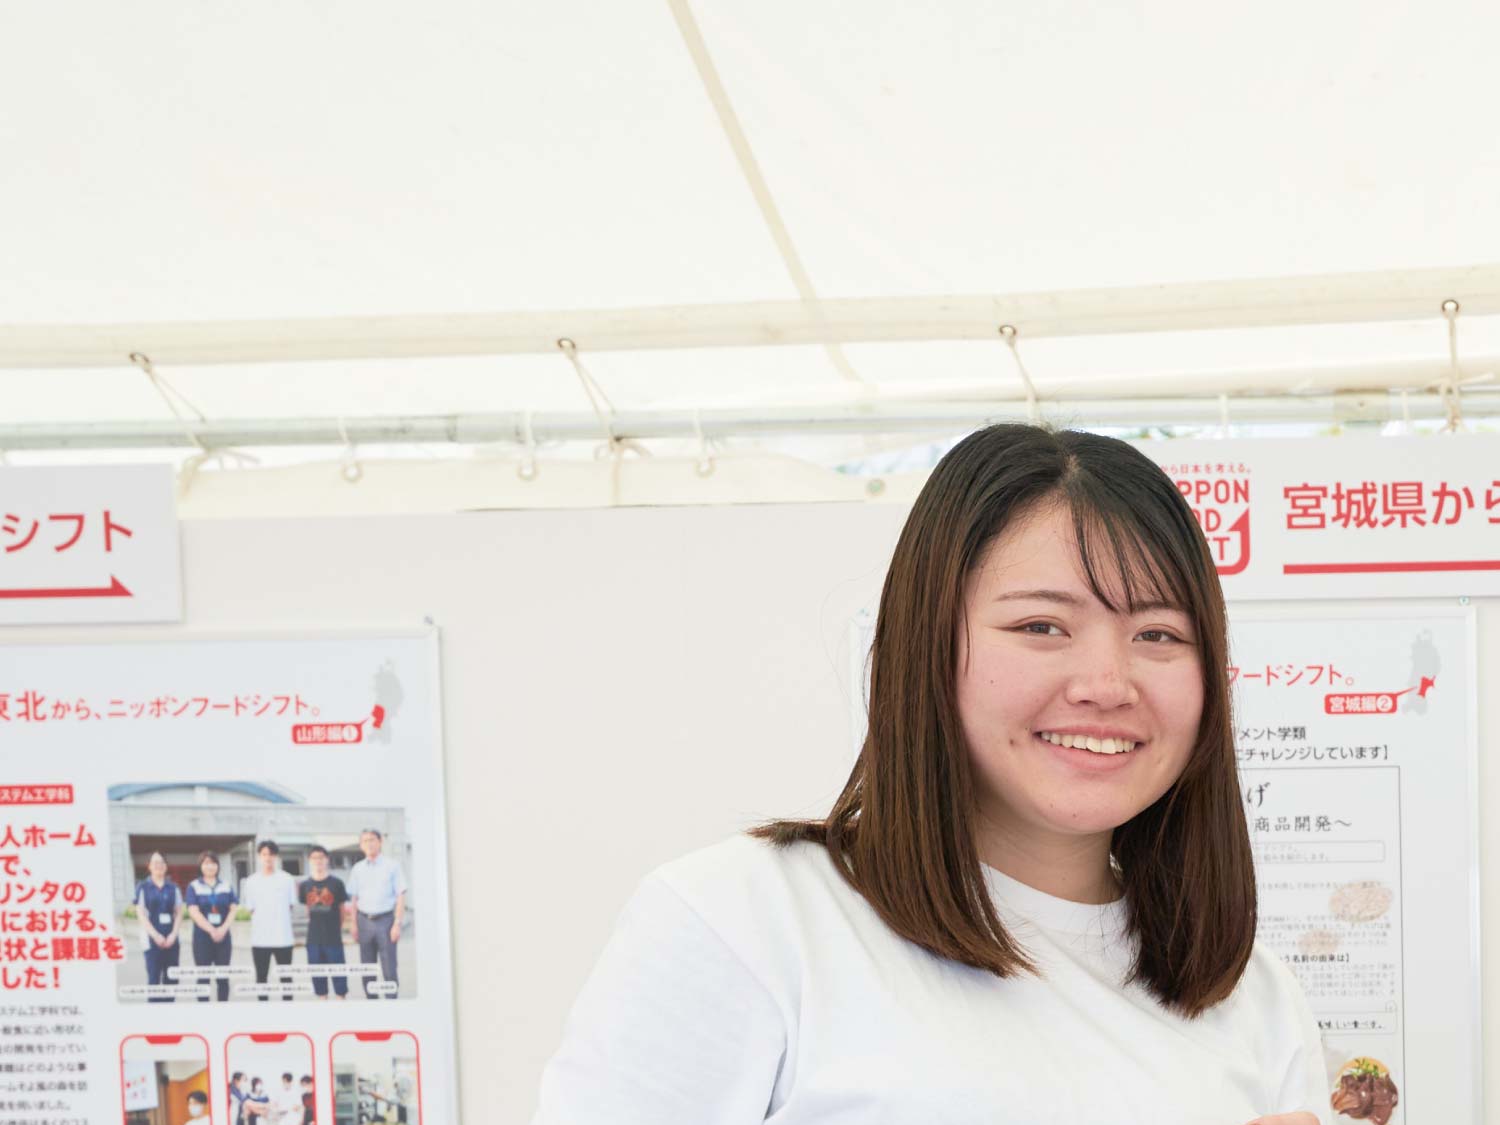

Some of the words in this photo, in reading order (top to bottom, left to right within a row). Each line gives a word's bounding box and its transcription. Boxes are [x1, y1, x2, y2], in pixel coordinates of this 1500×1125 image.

[0, 824, 96, 848] 人ホーム
[0, 855, 31, 876] で、
[1, 910, 107, 932] における、
